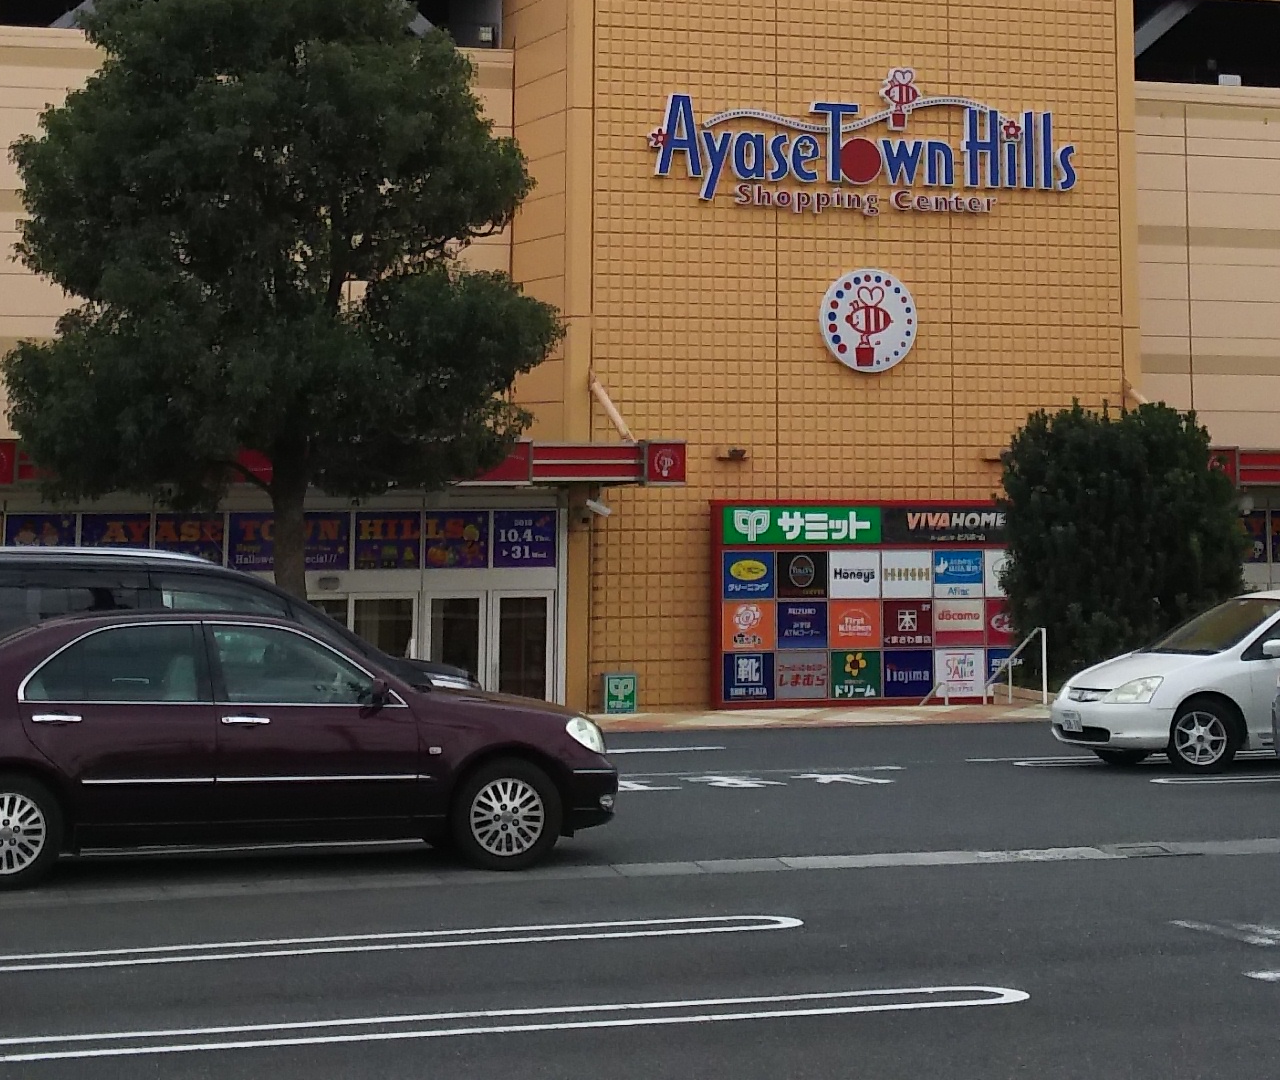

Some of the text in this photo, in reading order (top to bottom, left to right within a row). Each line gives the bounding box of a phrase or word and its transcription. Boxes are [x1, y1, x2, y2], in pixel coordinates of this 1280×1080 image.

[655, 92, 820, 201] Ayase
[961, 106, 1077, 191] Hills
[735, 183, 999, 217] Shopping Center
[778, 511, 870, 541] サミット
[499, 528, 533, 542] 10.4
[511, 545, 530, 559] 31
[235, 554, 275, 565] Hallowe
[833, 568, 875, 583] Honeys
[938, 609, 980, 620] docomo
[737, 658, 760, 682] 靴
[778, 673, 827, 687] しまむら
[835, 684, 876, 698] ドリーム
